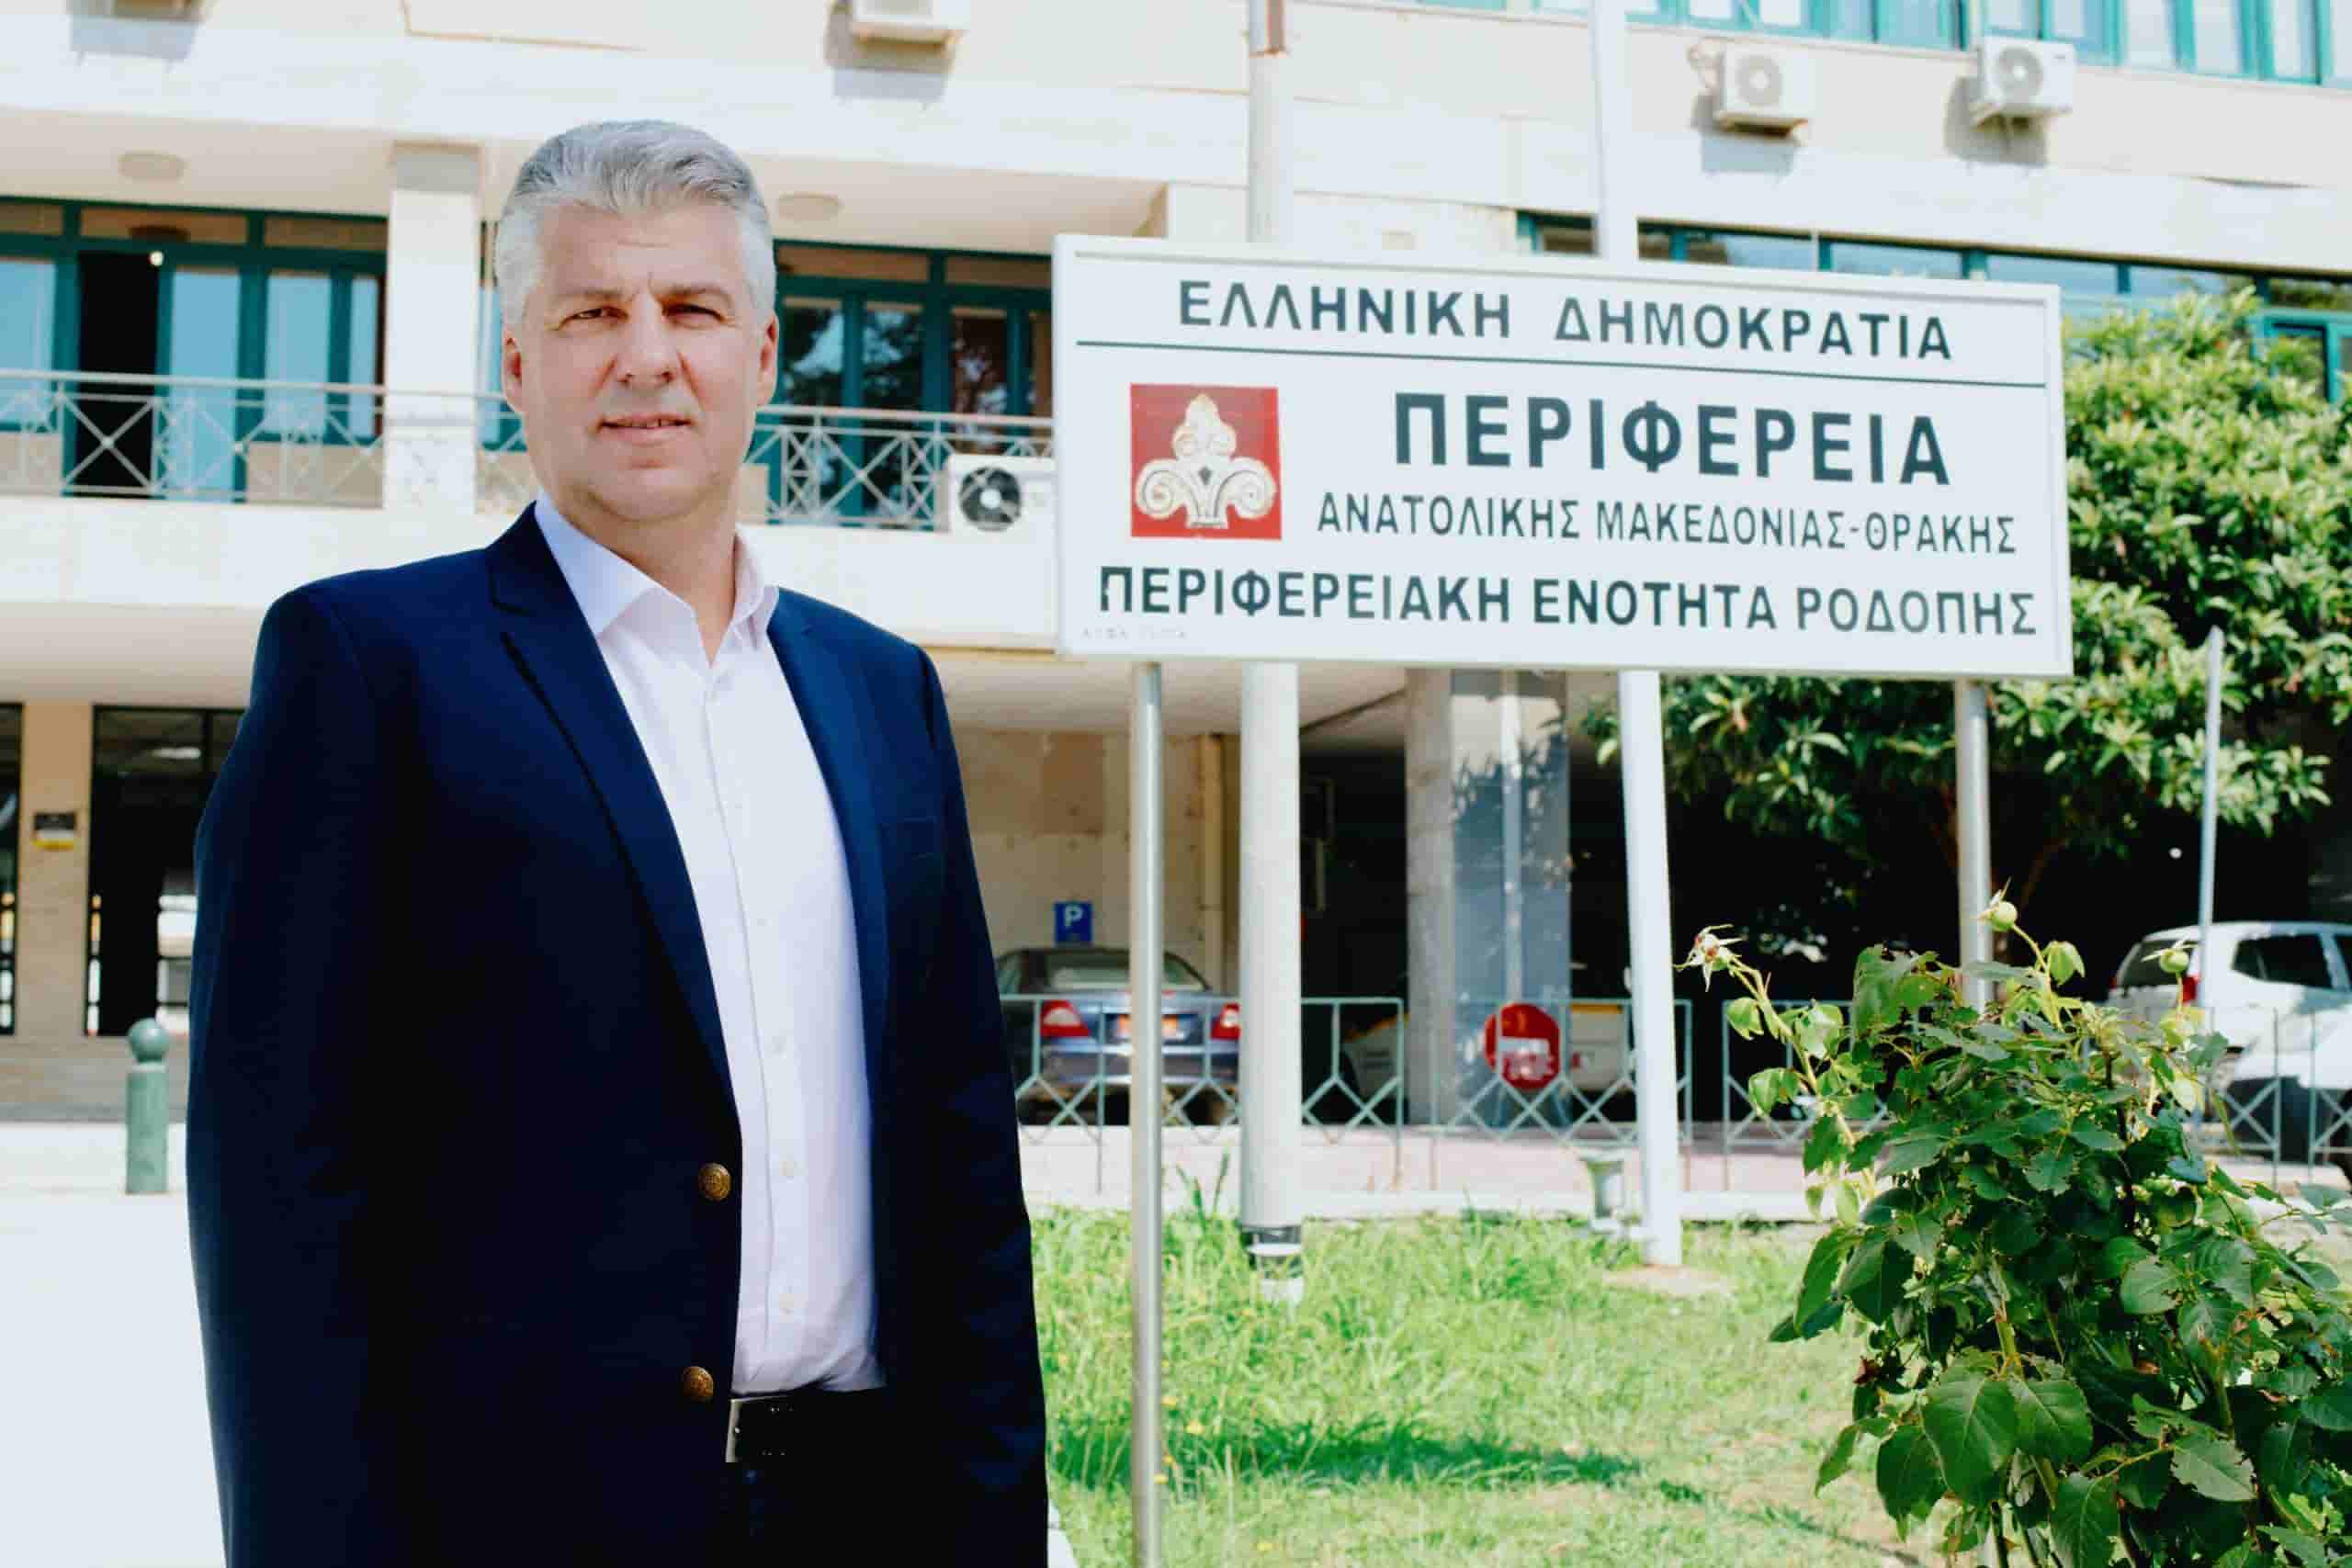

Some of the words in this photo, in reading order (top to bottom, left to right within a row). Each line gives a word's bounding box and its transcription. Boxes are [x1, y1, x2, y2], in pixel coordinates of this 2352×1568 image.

[1180, 280, 1510, 339] ΕΛΛΗΝΙΚΗ
[1555, 297, 1951, 361] ΔΗΜΟΚΡΑΤΙΑ
[1395, 392, 1951, 487] ΠΕΡΙΦΕΡΕΙΑ
[1317, 491, 1581, 539] ΑΝΑΤΟΛΙΚΗΣ
[1100, 565, 1510, 624] ΠΕΡΙΦΕΡΕΙΑΚΗ
[1532, 578, 1777, 630] ΕΝΟΤΗΤΑ
[1796, 586, 2038, 636] ΡΟΔΟΠΗΣ
[1064, 905, 1083, 928] P
